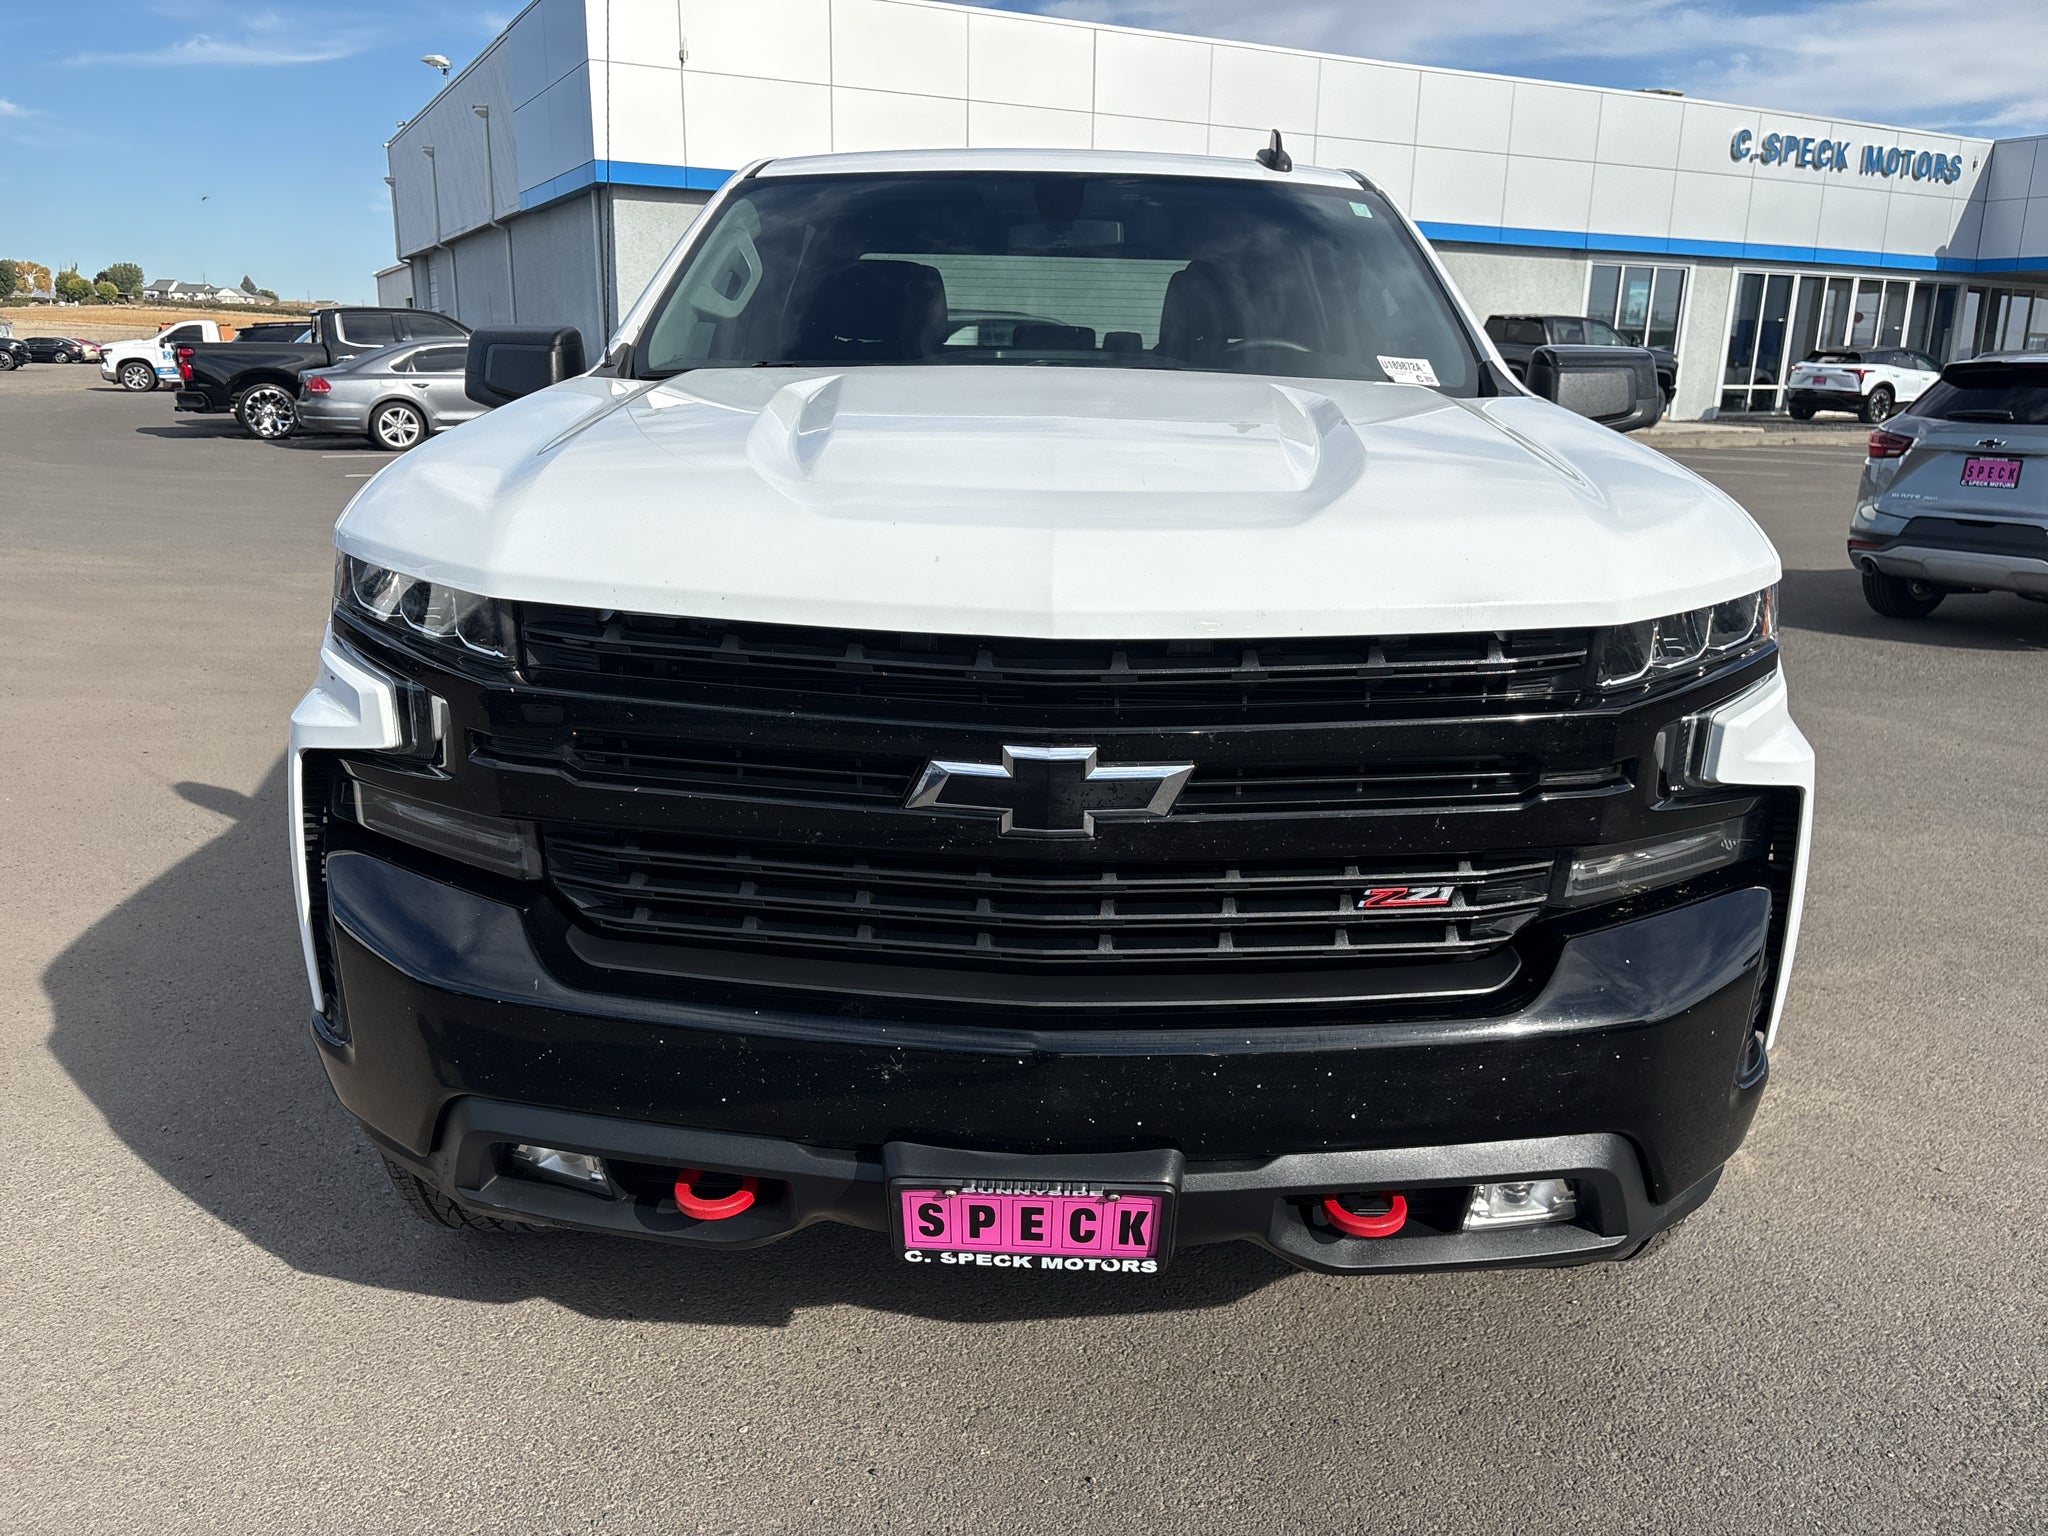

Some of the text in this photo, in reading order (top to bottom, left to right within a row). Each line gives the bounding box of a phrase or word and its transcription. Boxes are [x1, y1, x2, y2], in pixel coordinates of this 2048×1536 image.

[1859, 145, 1962, 184] MOTORS
[1967, 465, 2017, 480] SPECK
[1358, 886, 1455, 908] Z71
[918, 1202, 1149, 1246] SPECK
[904, 1250, 1158, 1274] C. SPECK MOTORS
